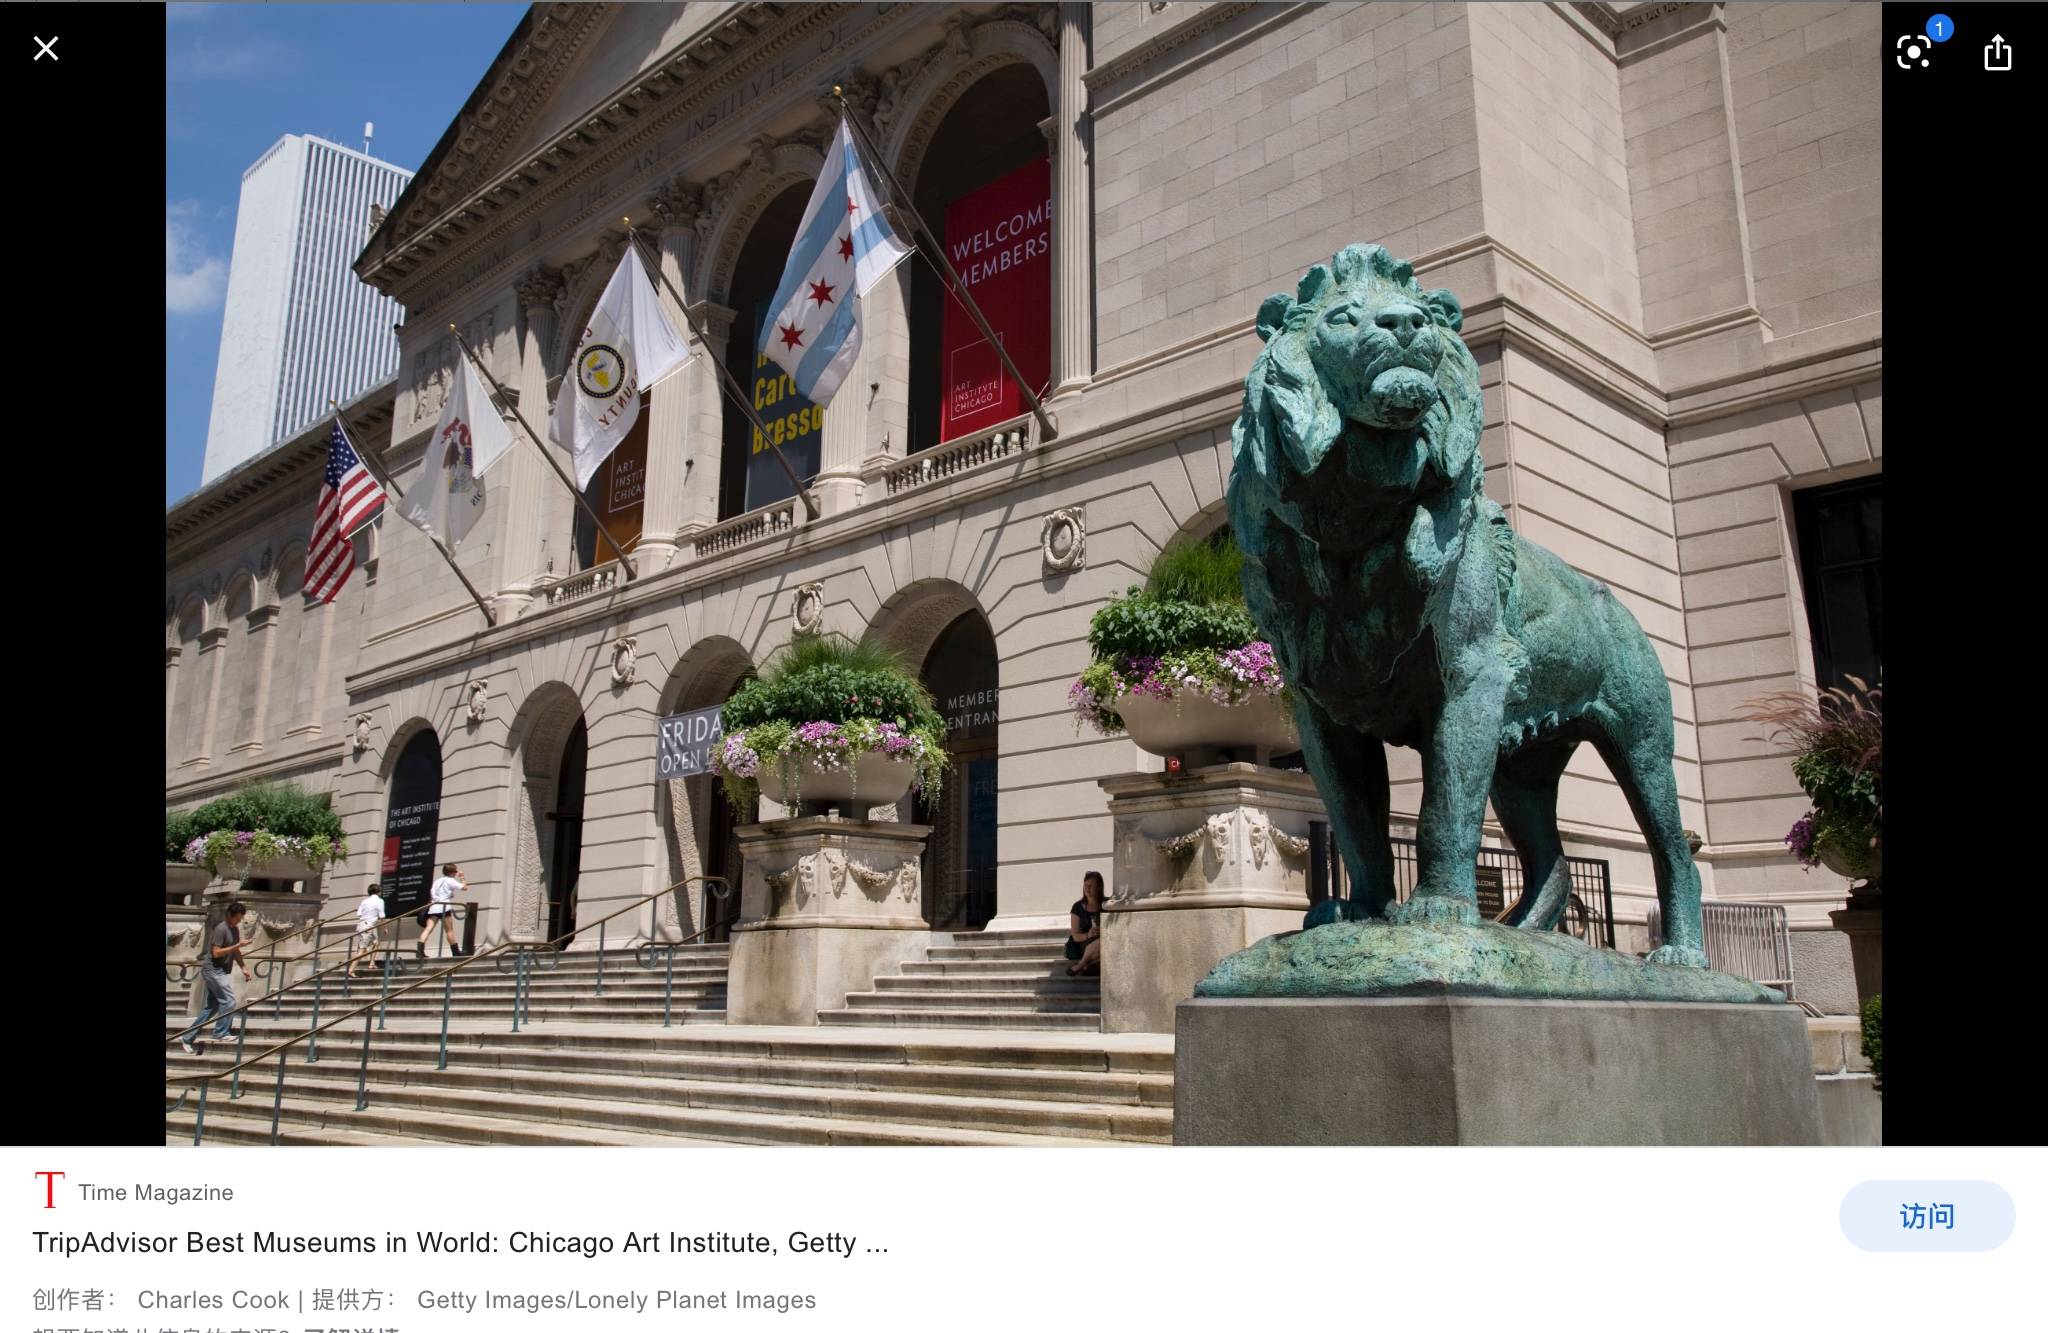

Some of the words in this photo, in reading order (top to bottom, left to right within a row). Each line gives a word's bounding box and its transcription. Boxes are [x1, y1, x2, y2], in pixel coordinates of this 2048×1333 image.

[632, 145, 662, 174] ART
[819, 25, 850, 53] OF
[953, 199, 1053, 262] WELCOME
[955, 380, 971, 393] ART
[955, 392, 993, 413] CHICAGO
[616, 459, 634, 476] ART
[661, 749, 700, 774] OPEN
[401, 806, 412, 815] ART
[396, 816, 421, 828] CHICAGO
